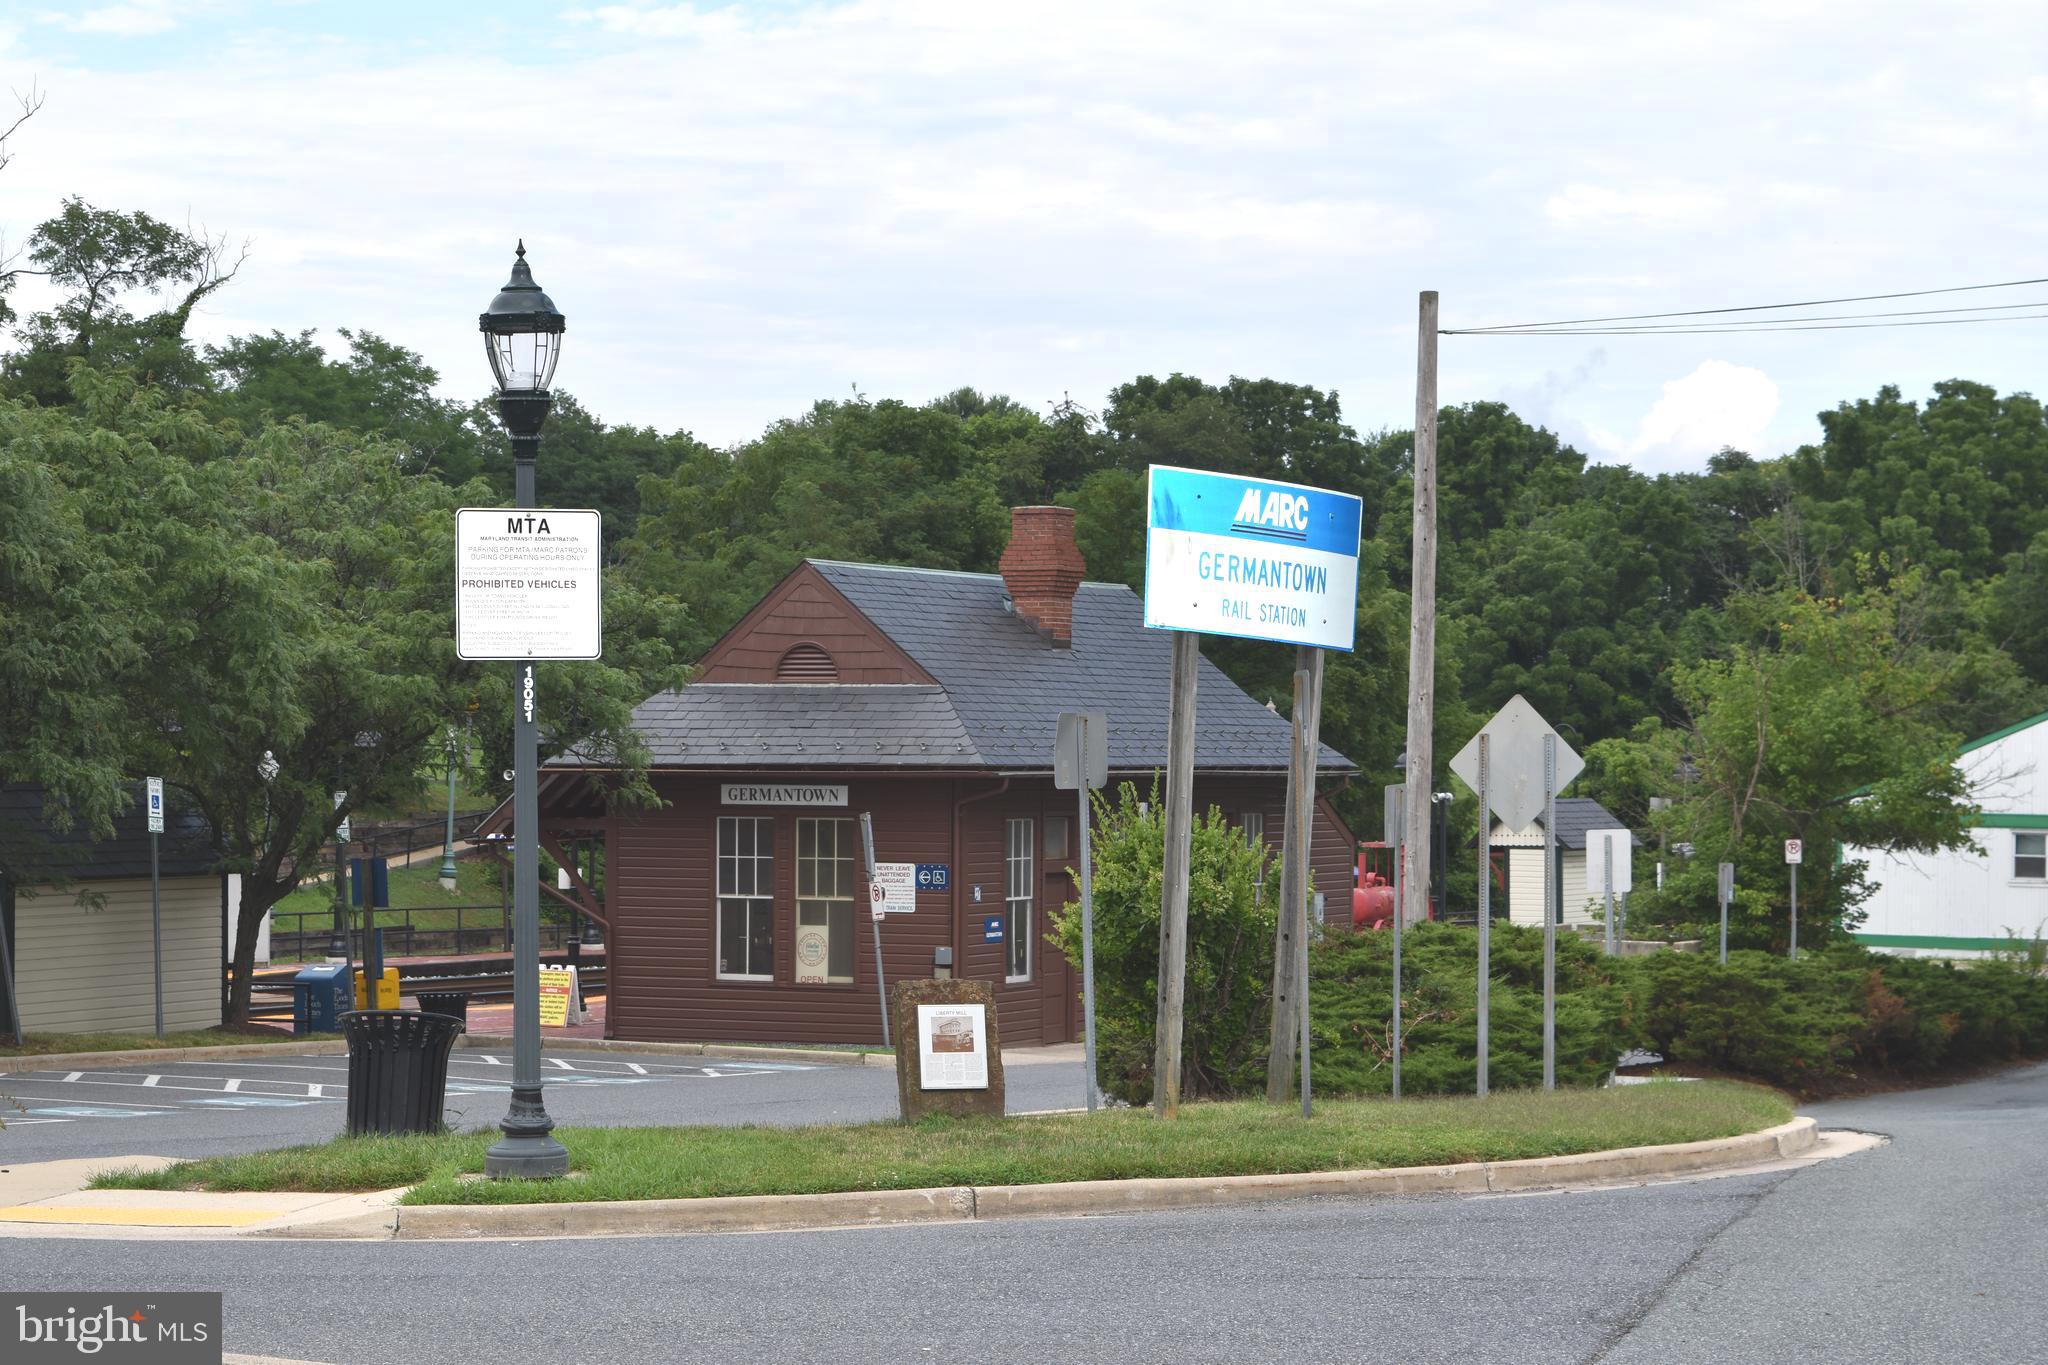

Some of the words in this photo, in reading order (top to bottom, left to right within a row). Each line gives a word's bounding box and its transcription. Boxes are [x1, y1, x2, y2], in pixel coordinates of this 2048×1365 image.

[1234, 488, 1309, 530] MARC
[507, 518, 550, 534] MTA
[1199, 551, 1327, 595] GERMANTOWN
[462, 580, 524, 589] PROHIBITED
[527, 580, 577, 589] VEHICLES
[1222, 599, 1252, 620] RAIL
[1259, 603, 1306, 628] STATION
[523, 665, 534, 723] 19051
[728, 787, 839, 802] GERMANTOWN
[800, 976, 824, 984] OPEN
